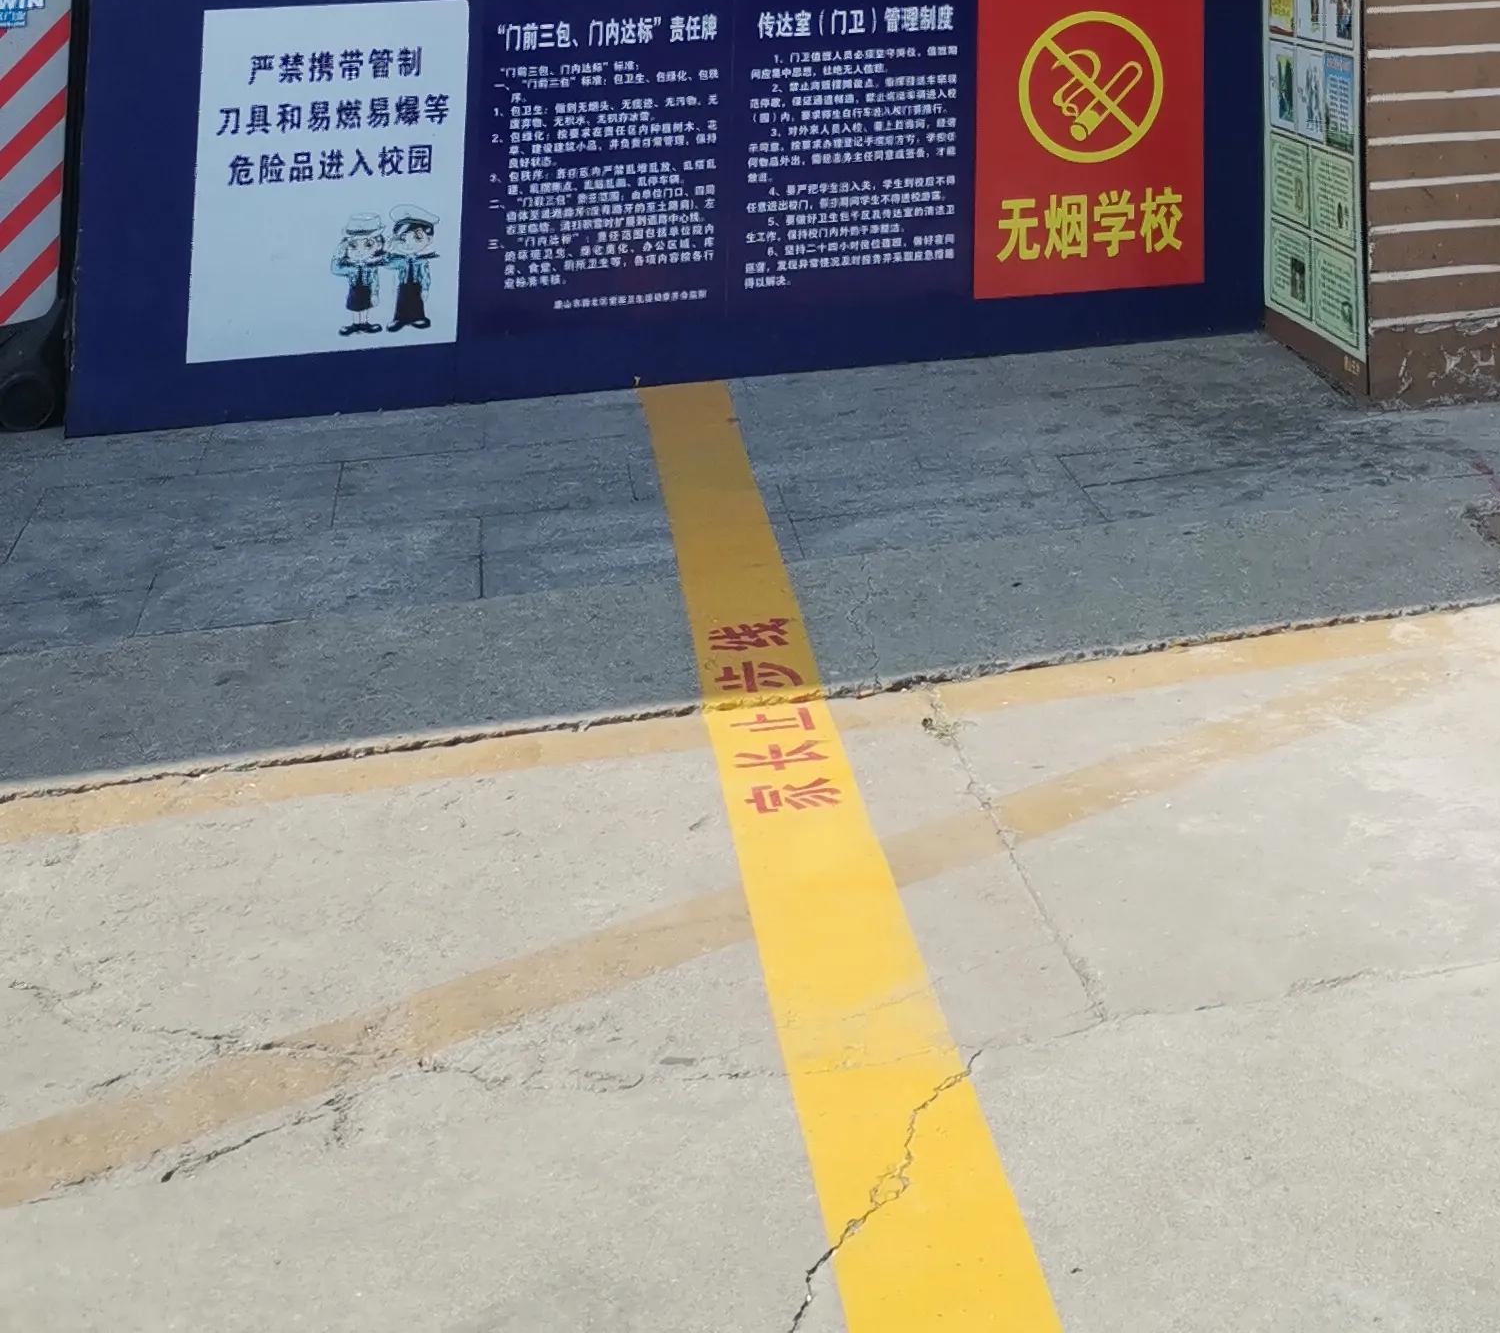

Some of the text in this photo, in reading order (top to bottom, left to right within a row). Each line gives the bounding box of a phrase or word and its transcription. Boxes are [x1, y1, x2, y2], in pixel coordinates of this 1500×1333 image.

[757, 4, 954, 39] 传达室（门卫）管理制度
[248, 46, 422, 85] 严禁携带管制
[216, 93, 449, 136] 刀具和易燃易爆等
[228, 144, 432, 186] 危险品进入校园
[996, 186, 1183, 262] 无烟学校
[708, 618, 843, 814] 家长止步线
